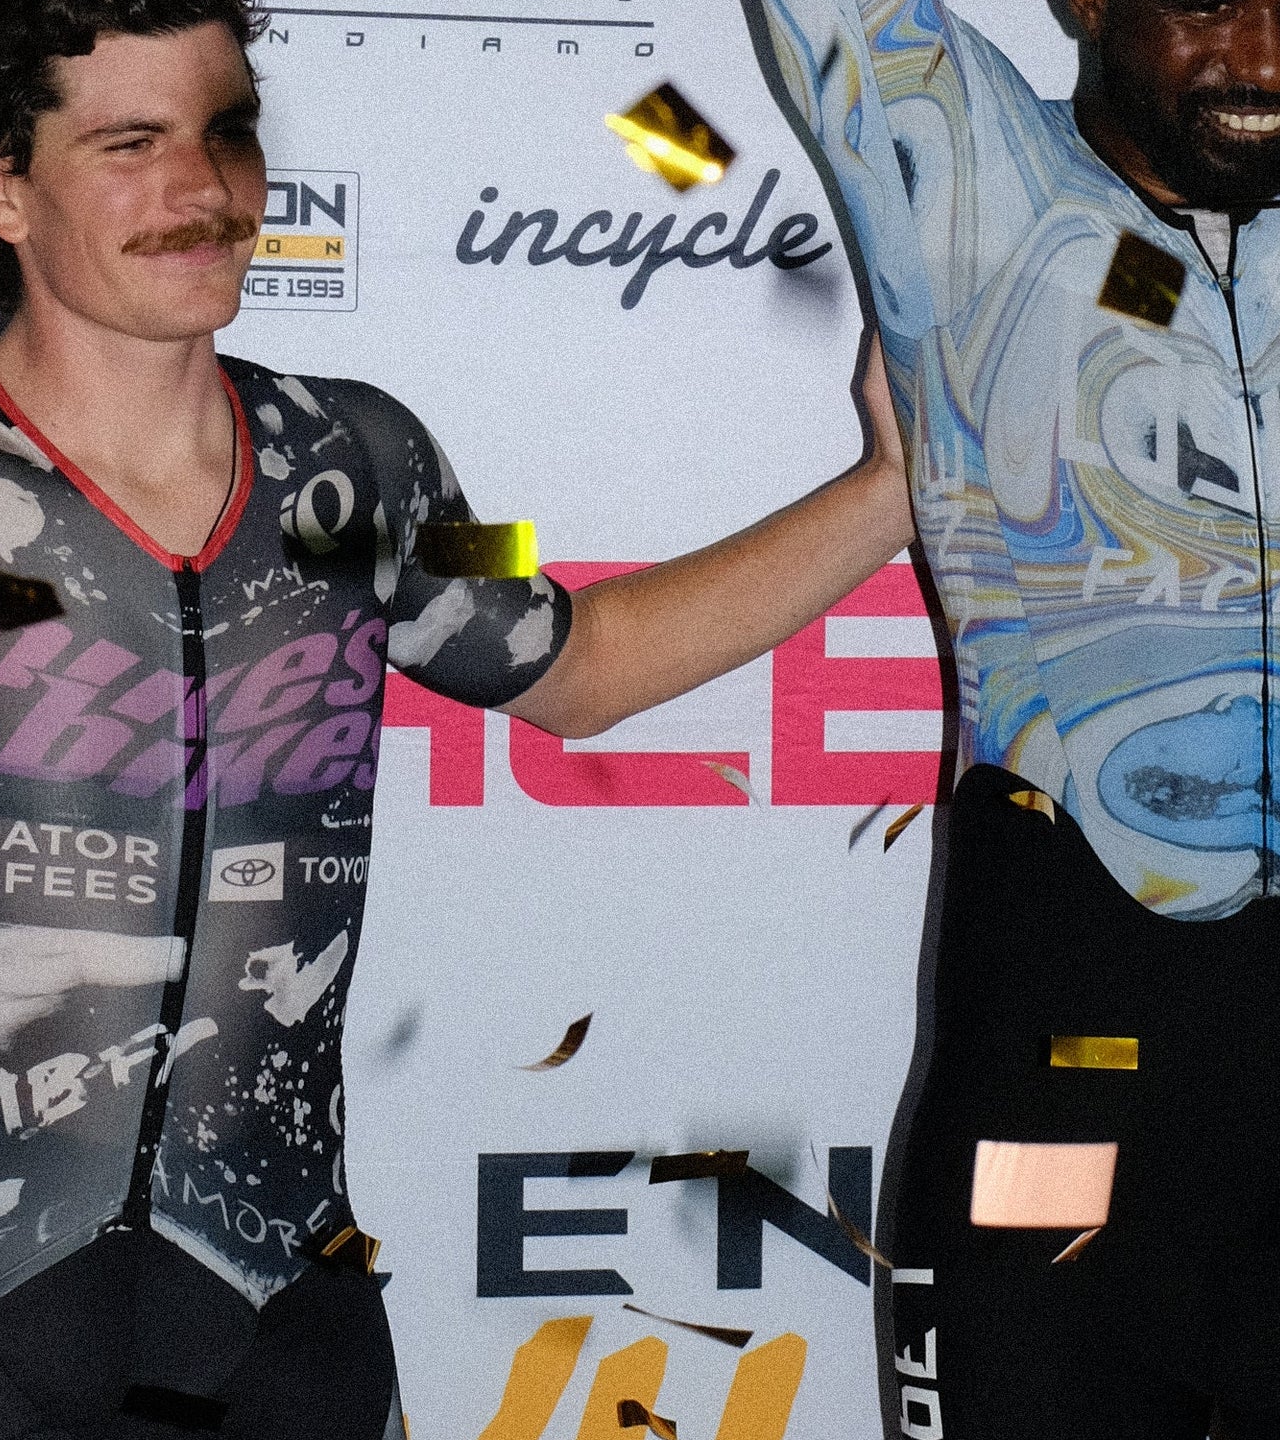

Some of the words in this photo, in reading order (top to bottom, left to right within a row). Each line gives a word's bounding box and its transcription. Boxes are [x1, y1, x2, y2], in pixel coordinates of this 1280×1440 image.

[269, 28, 654, 58] NDIAMO
[456, 168, 833, 310] incycle
[286, 278, 344, 299] 1993
[298, 855, 371, 885] TOYOT
